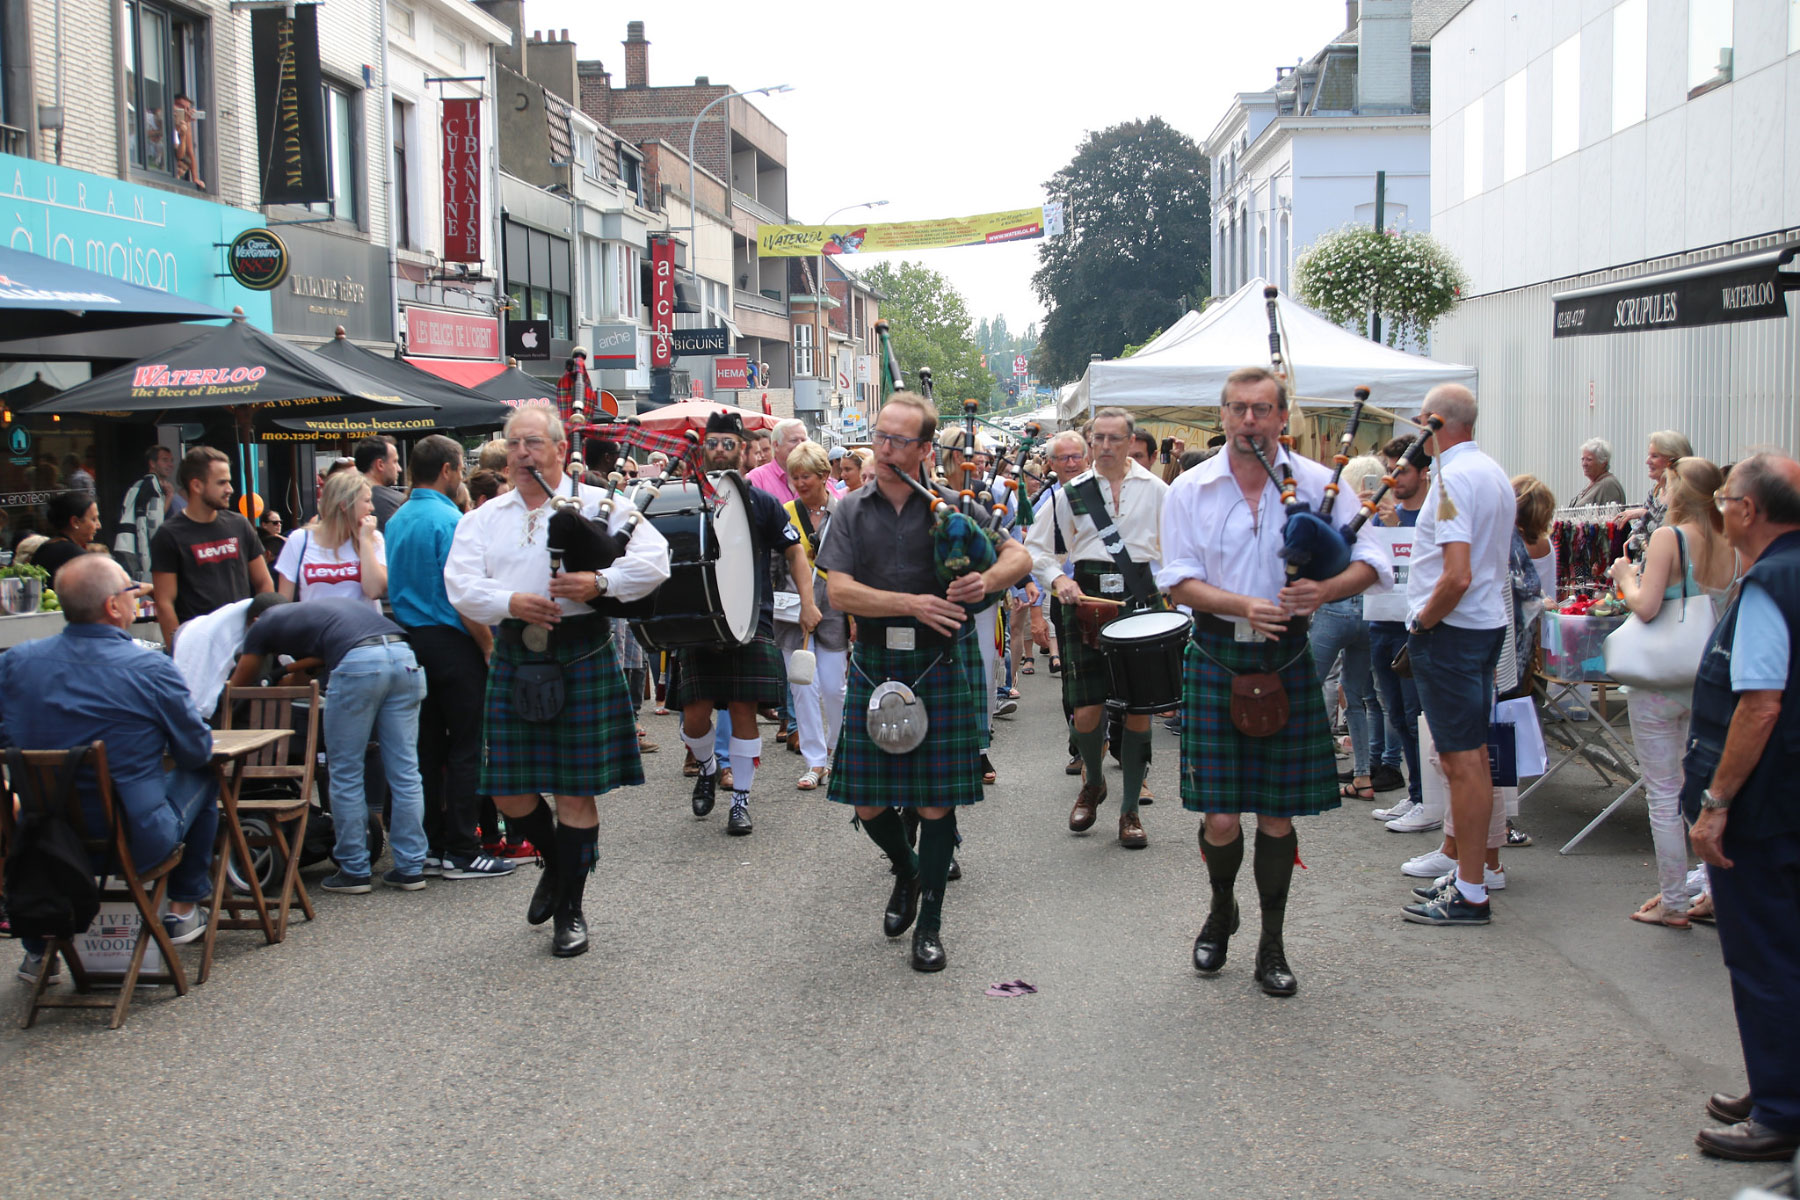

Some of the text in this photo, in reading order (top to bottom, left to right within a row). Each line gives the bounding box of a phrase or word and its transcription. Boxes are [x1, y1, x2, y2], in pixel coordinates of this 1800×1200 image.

[281, 87, 303, 188] MADAME
[446, 119, 459, 237] CUISINE
[464, 102, 479, 254] LIBANAISE
[87, 237, 179, 293] maison
[656, 260, 670, 359] arche
[1613, 291, 1678, 327] SCRUPULES
[1722, 281, 1775, 310] WATERLOO
[416, 320, 428, 343] LES
[599, 330, 631, 349] arche
[674, 338, 725, 350] BIGUINE
[133, 365, 266, 387] WATERLOO
[717, 369, 745, 378] HEMA
[131, 382, 259, 397] The Beer of Bravery!
[305, 417, 435, 430] waterloo-beer.com
